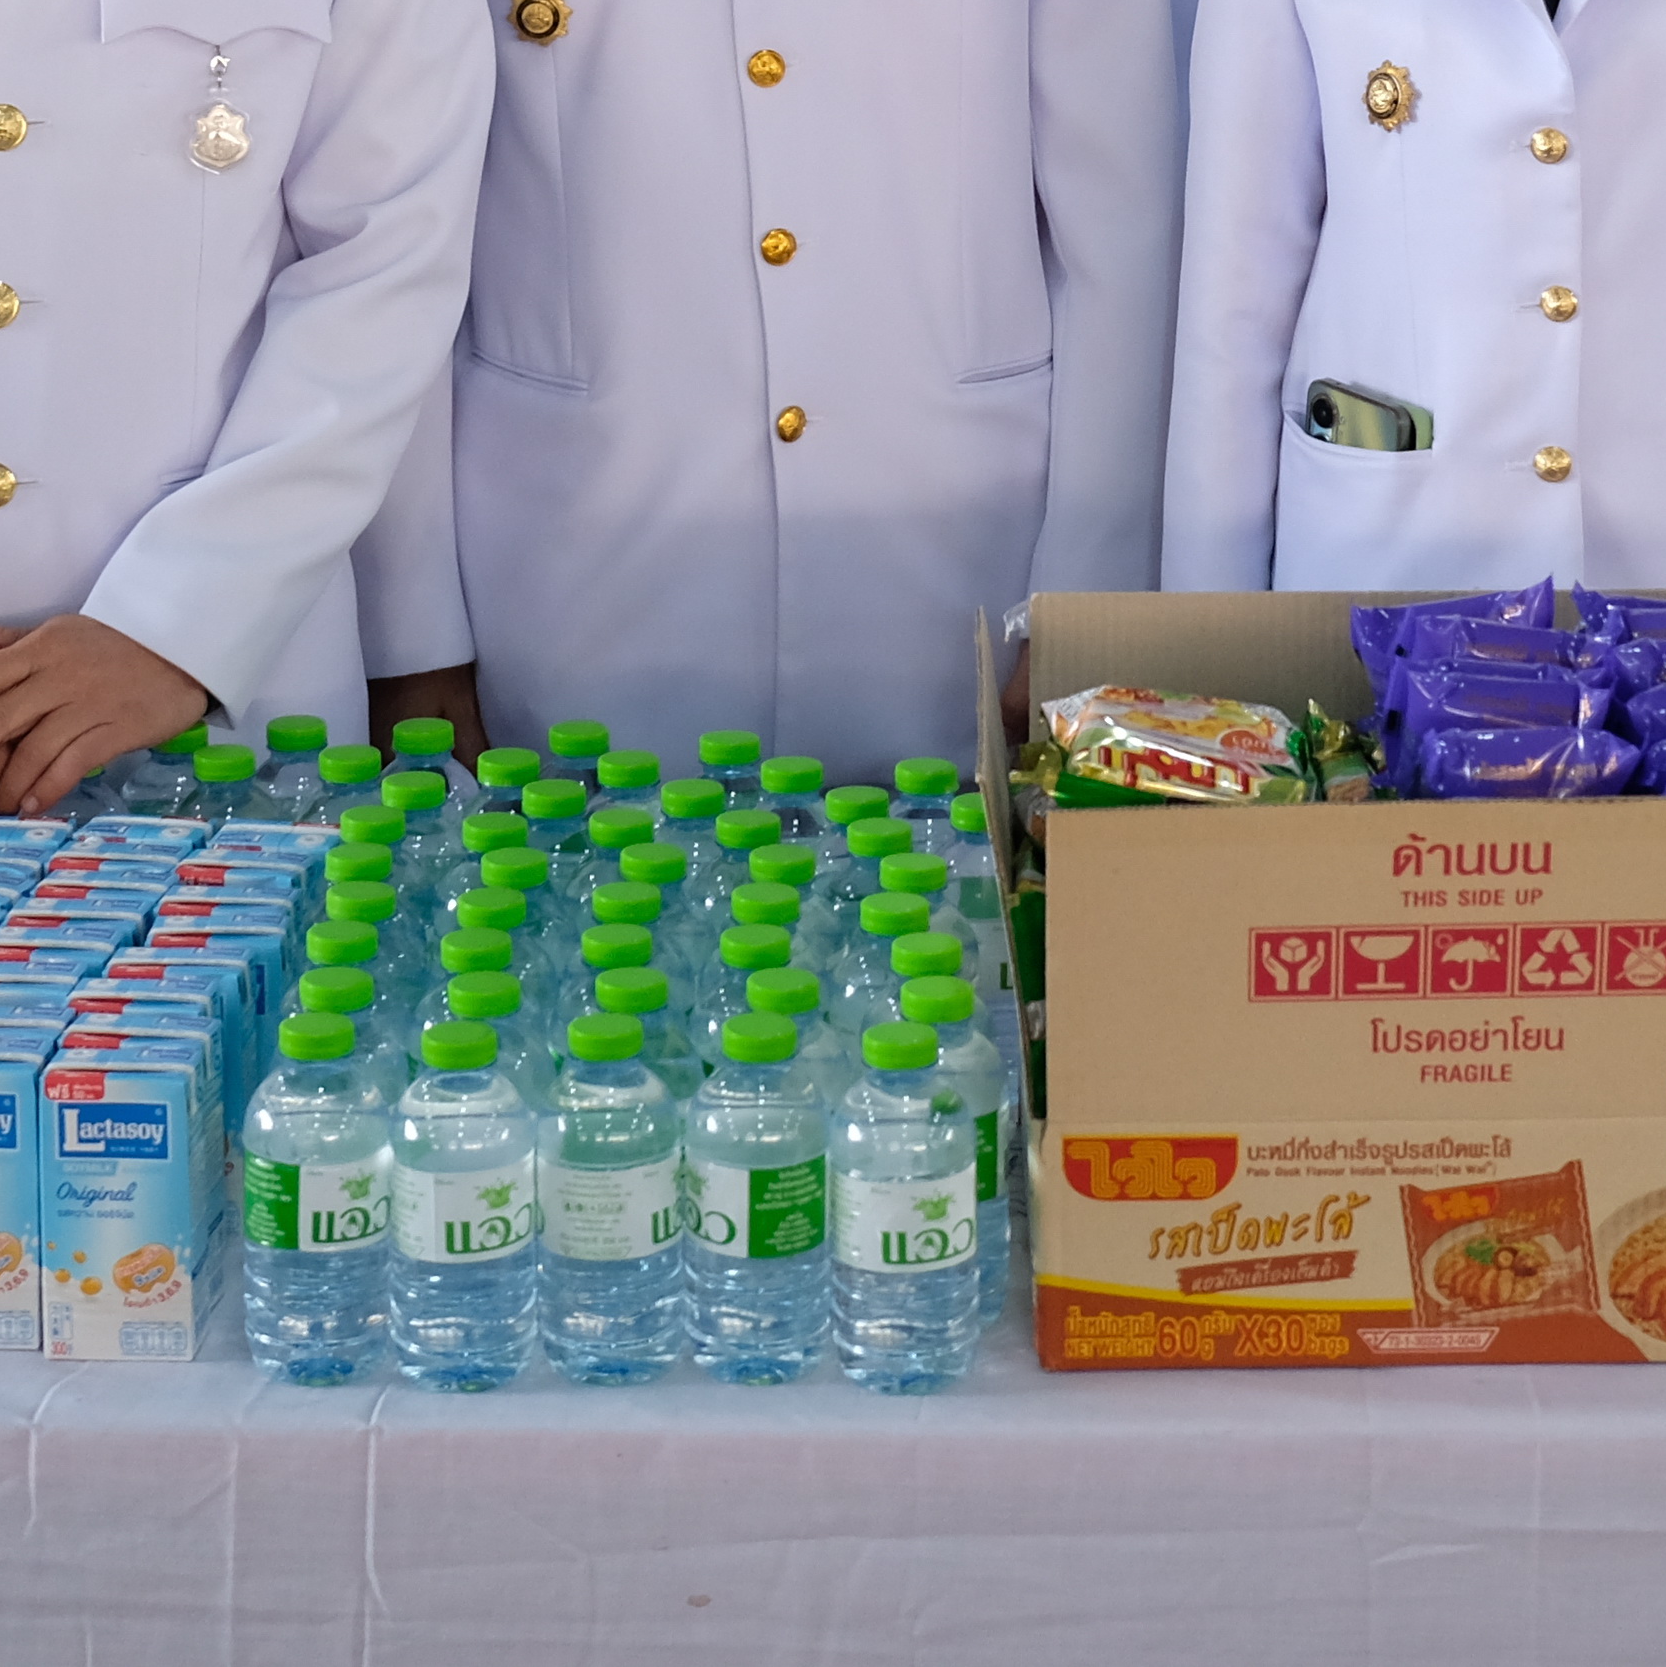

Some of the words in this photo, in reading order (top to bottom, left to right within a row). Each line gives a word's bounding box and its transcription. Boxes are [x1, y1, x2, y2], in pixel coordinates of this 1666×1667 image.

[1392, 833, 1553, 877] ด้านบน
[1402, 890, 1448, 907] THIS
[1458, 889, 1505, 907] SIDE
[1516, 888, 1543, 906] UP
[1371, 1016, 1565, 1054] โปรดอย่าโยน
[1421, 1063, 1513, 1083] FRAGILE
[63, 1109, 165, 1152] Lactasoy
[1067, 1140, 1217, 1199] ไวไว
[57, 1182, 138, 1208] Original
[1147, 1191, 1371, 1260] รสเป็ดพะโล้
[1156, 1317, 1199, 1358] 60
